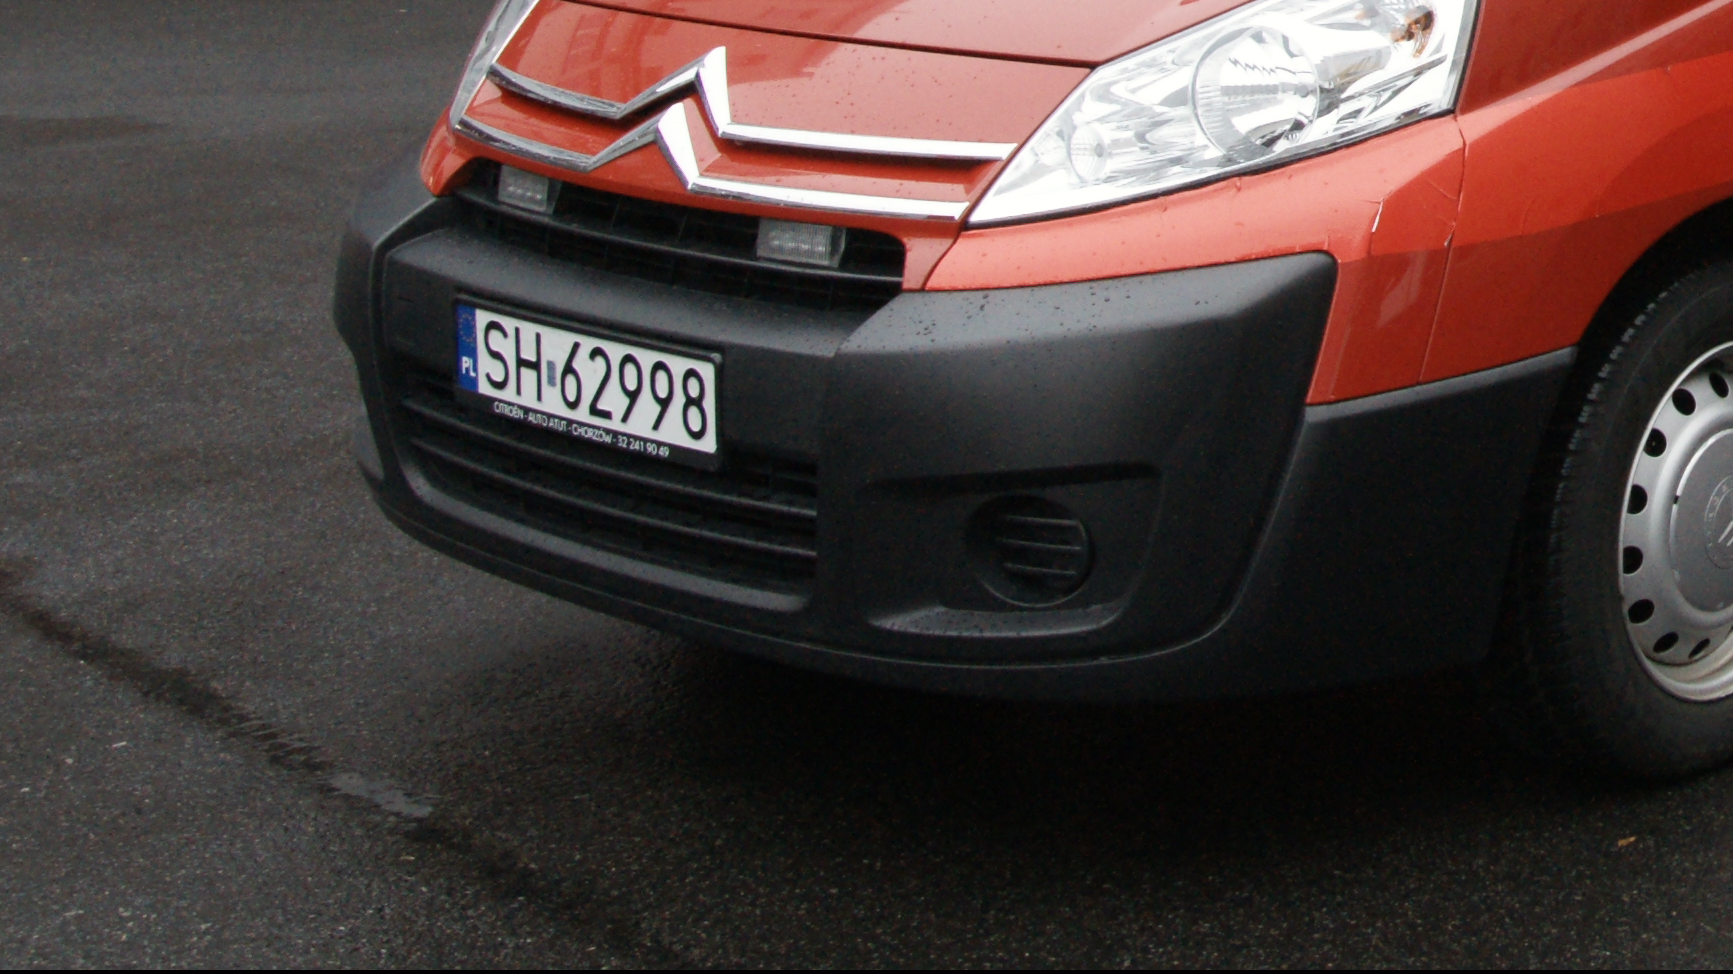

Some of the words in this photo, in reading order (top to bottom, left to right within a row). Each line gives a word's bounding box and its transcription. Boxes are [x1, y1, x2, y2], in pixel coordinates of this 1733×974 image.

[462, 355, 476, 376] PL
[484, 320, 543, 402] SH
[560, 341, 708, 440] 62998
[528, 411, 548, 426] AUTO
[618, 435, 628, 448] 32
[629, 436, 644, 452] 241
[646, 442, 658, 456] 90
